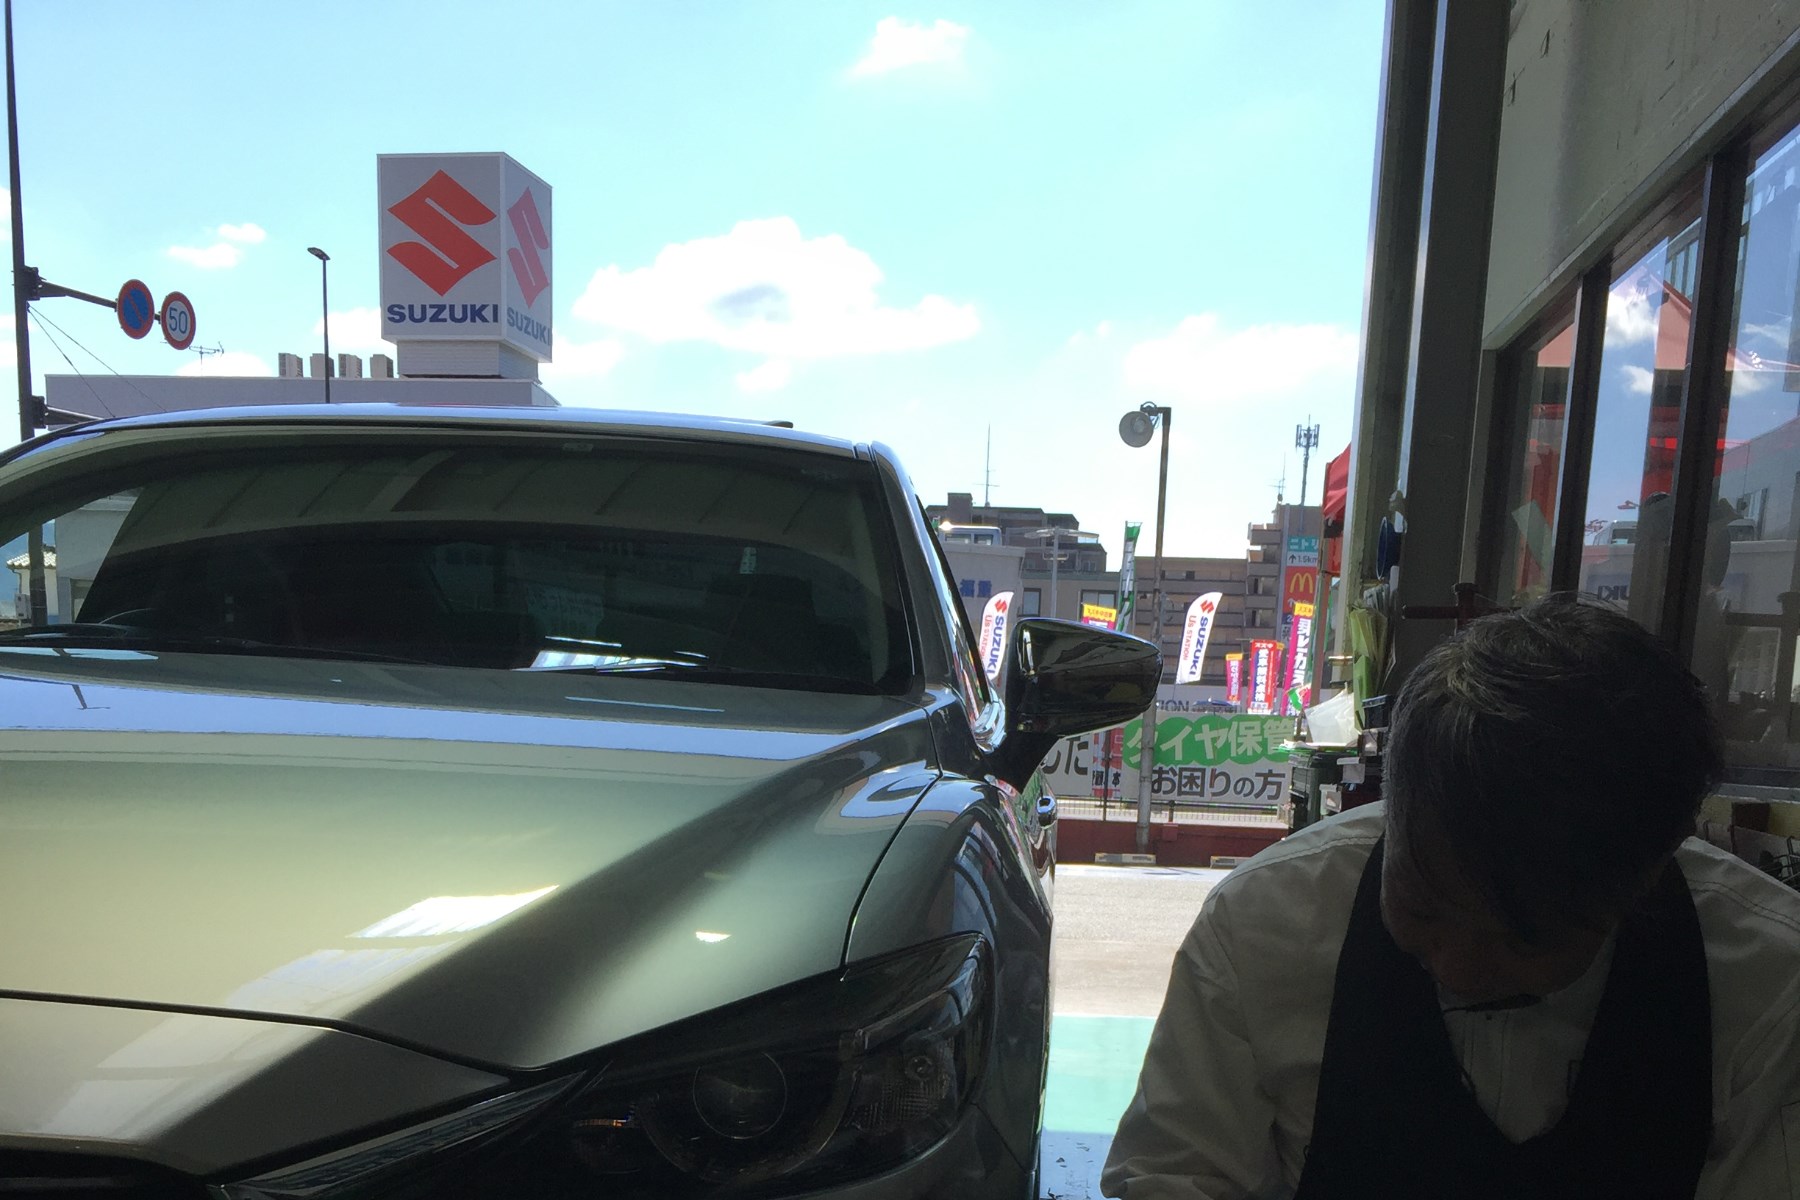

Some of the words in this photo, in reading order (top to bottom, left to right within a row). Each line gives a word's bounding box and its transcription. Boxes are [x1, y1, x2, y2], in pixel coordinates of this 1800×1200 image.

[168, 306, 189, 335] 50
[387, 303, 499, 324] SUZUKI
[506, 306, 551, 346] SUZUKI
[1289, 538, 1319, 551] ニトリ
[986, 615, 1005, 674] SUZUKI
[1189, 615, 1209, 676] SUZUKI
[1150, 766, 1286, 802] お困りの方
